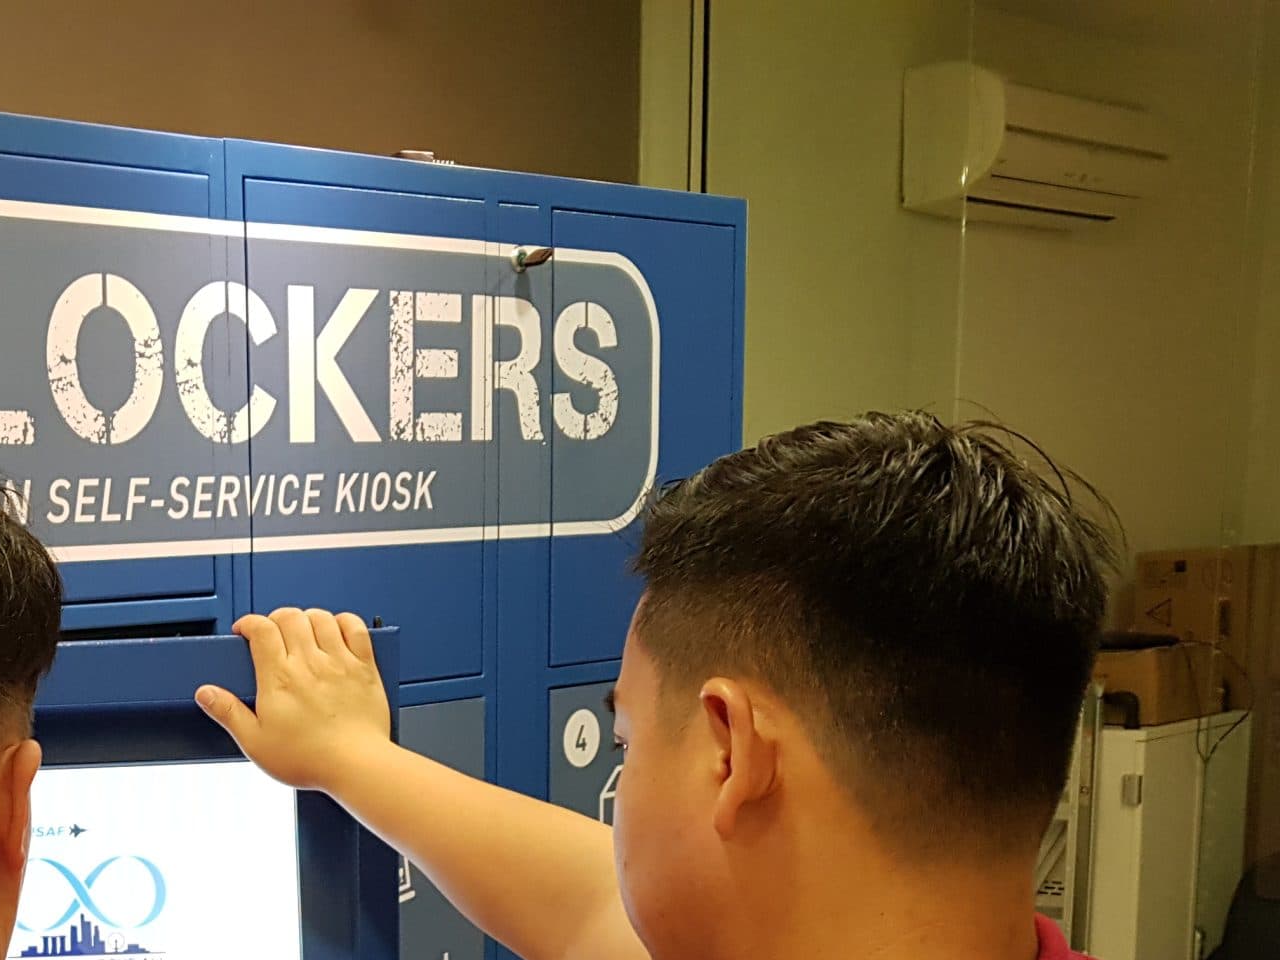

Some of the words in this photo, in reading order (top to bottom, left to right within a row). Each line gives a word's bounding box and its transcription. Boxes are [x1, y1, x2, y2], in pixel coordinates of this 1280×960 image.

[46, 473, 325, 524] SELF-SERVICE
[335, 470, 437, 513] KIOSK
[575, 724, 587, 751] 4
[32, 826, 65, 838] SAF
